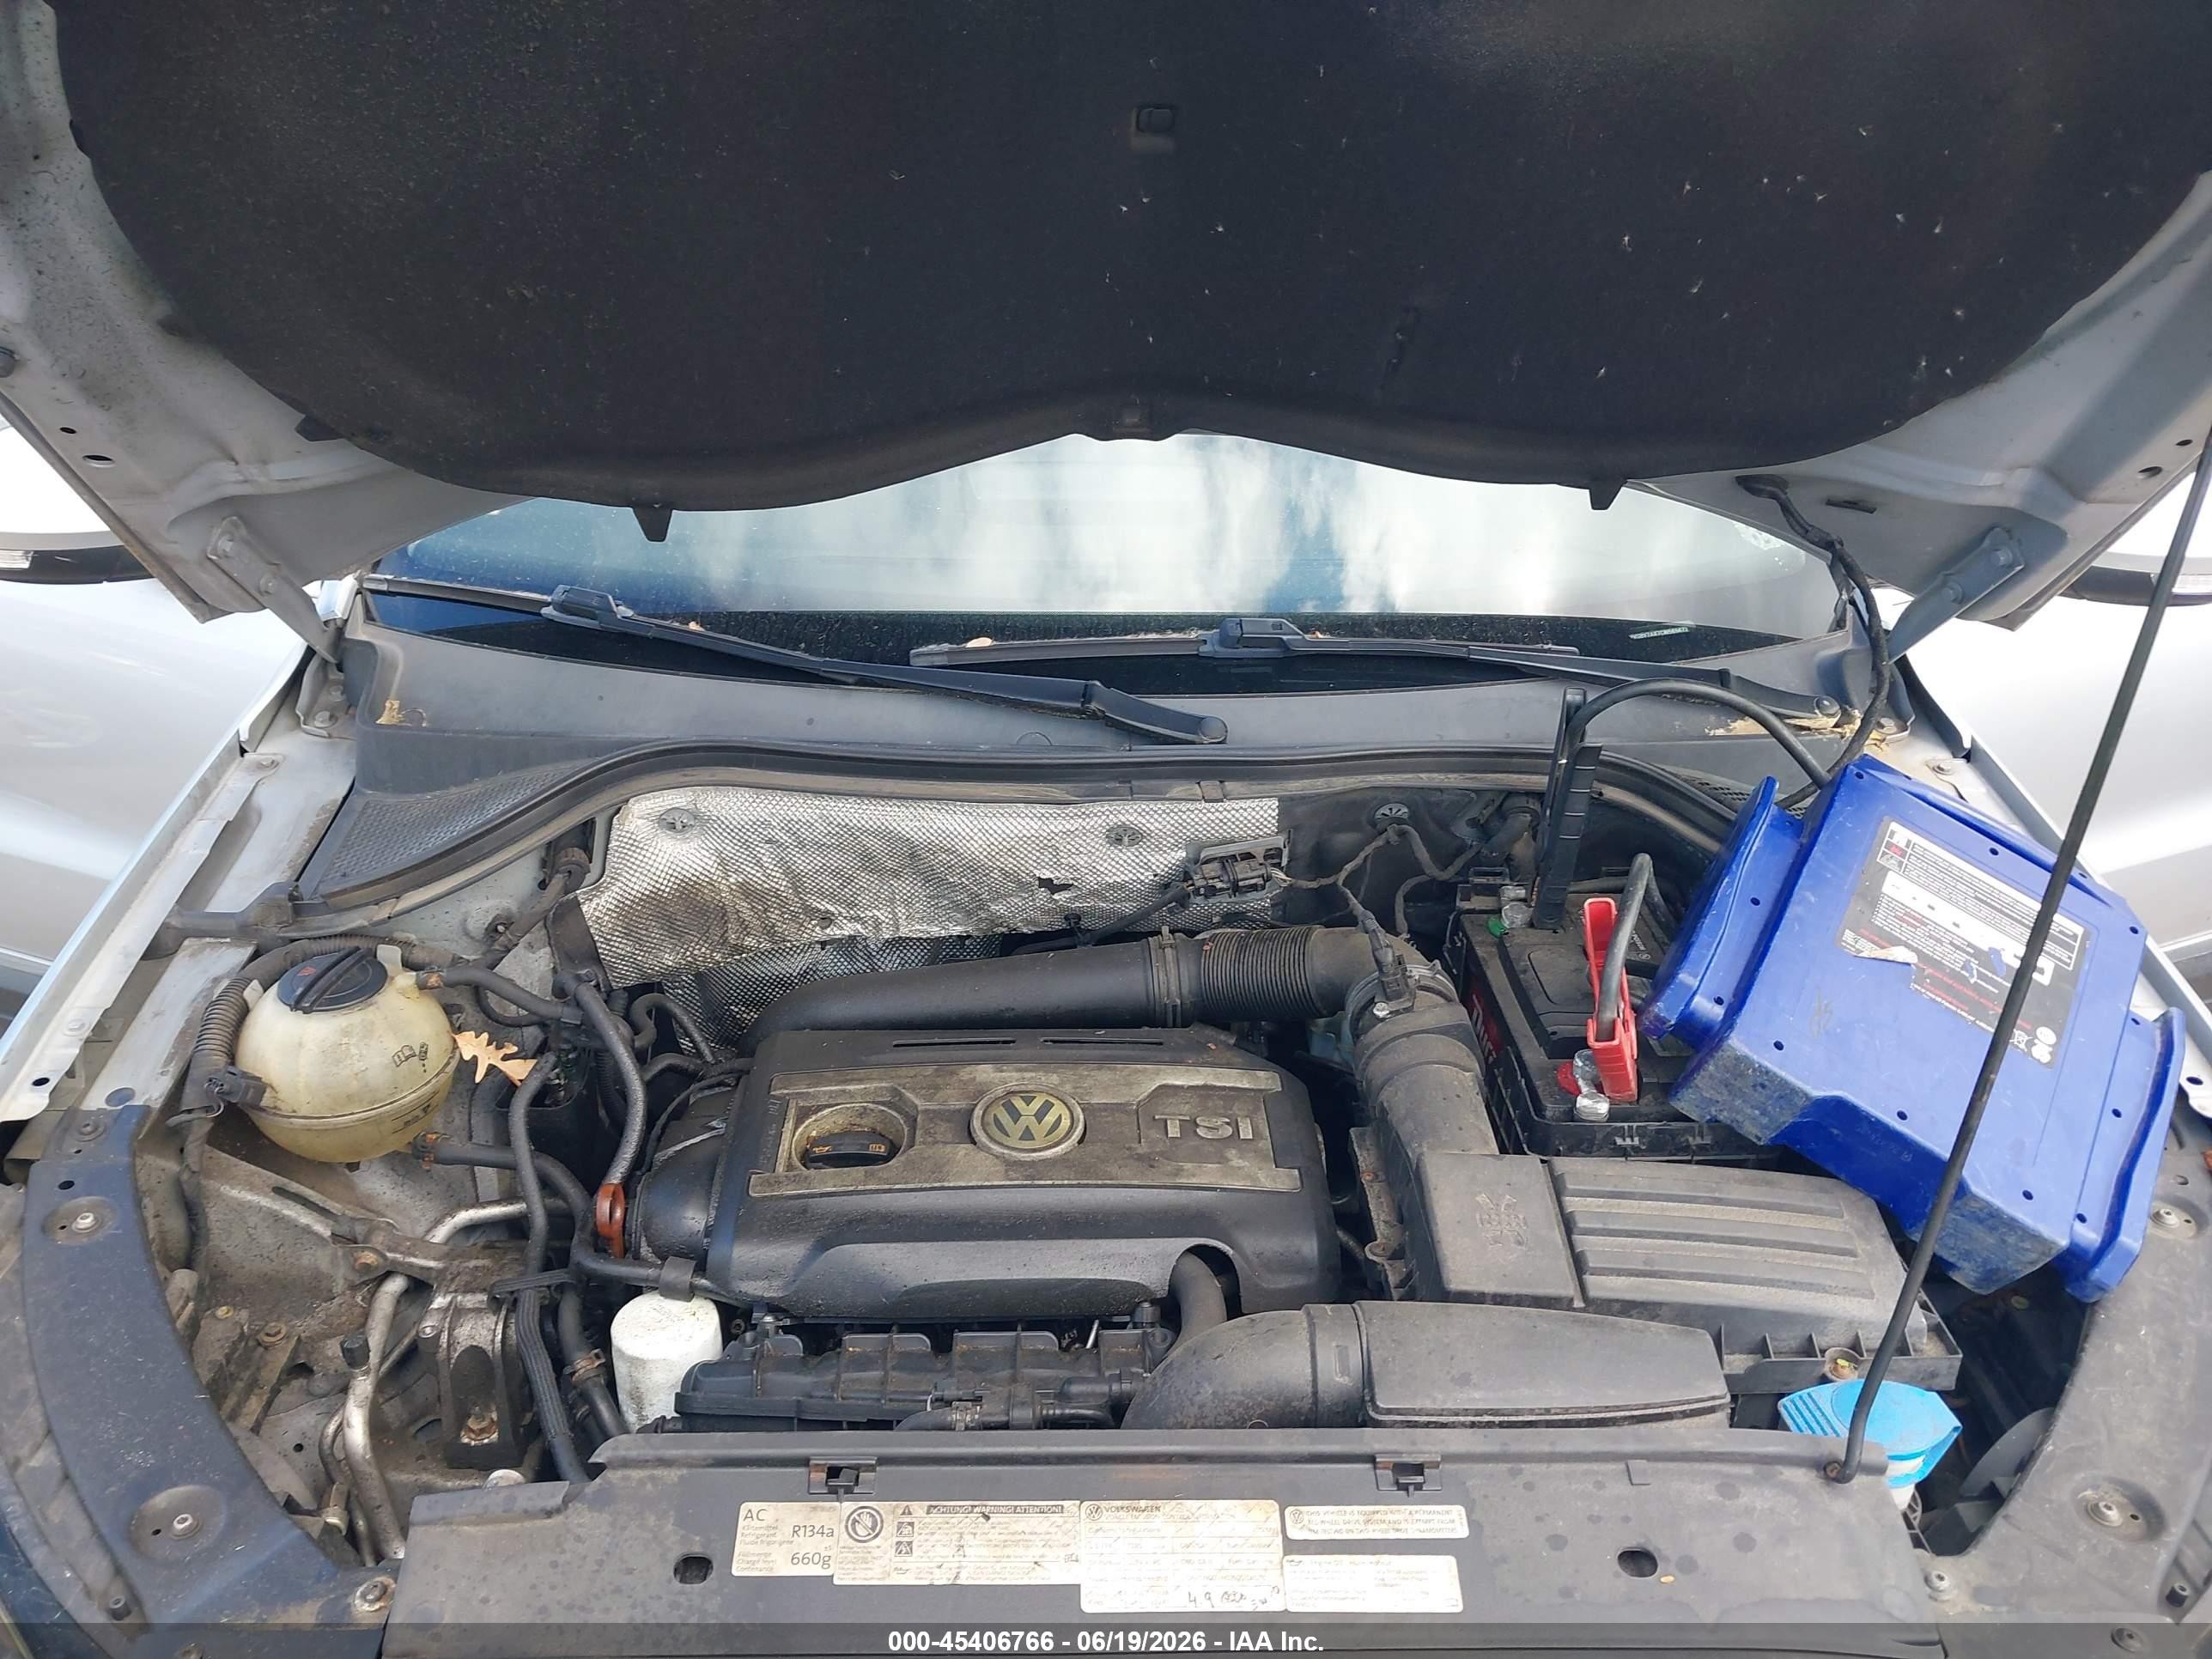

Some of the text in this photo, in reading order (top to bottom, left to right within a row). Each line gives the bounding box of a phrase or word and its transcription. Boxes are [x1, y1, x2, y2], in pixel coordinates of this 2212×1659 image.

[1154, 1115, 1254, 1140] TSI
[743, 1508, 769, 1522] AC
[973, 1505, 1015, 1514] WARNING!
[1016, 1505, 1062, 1514] ATTENTION!
[791, 1524, 835, 1538] R134a
[791, 1552, 832, 1570] 660g
